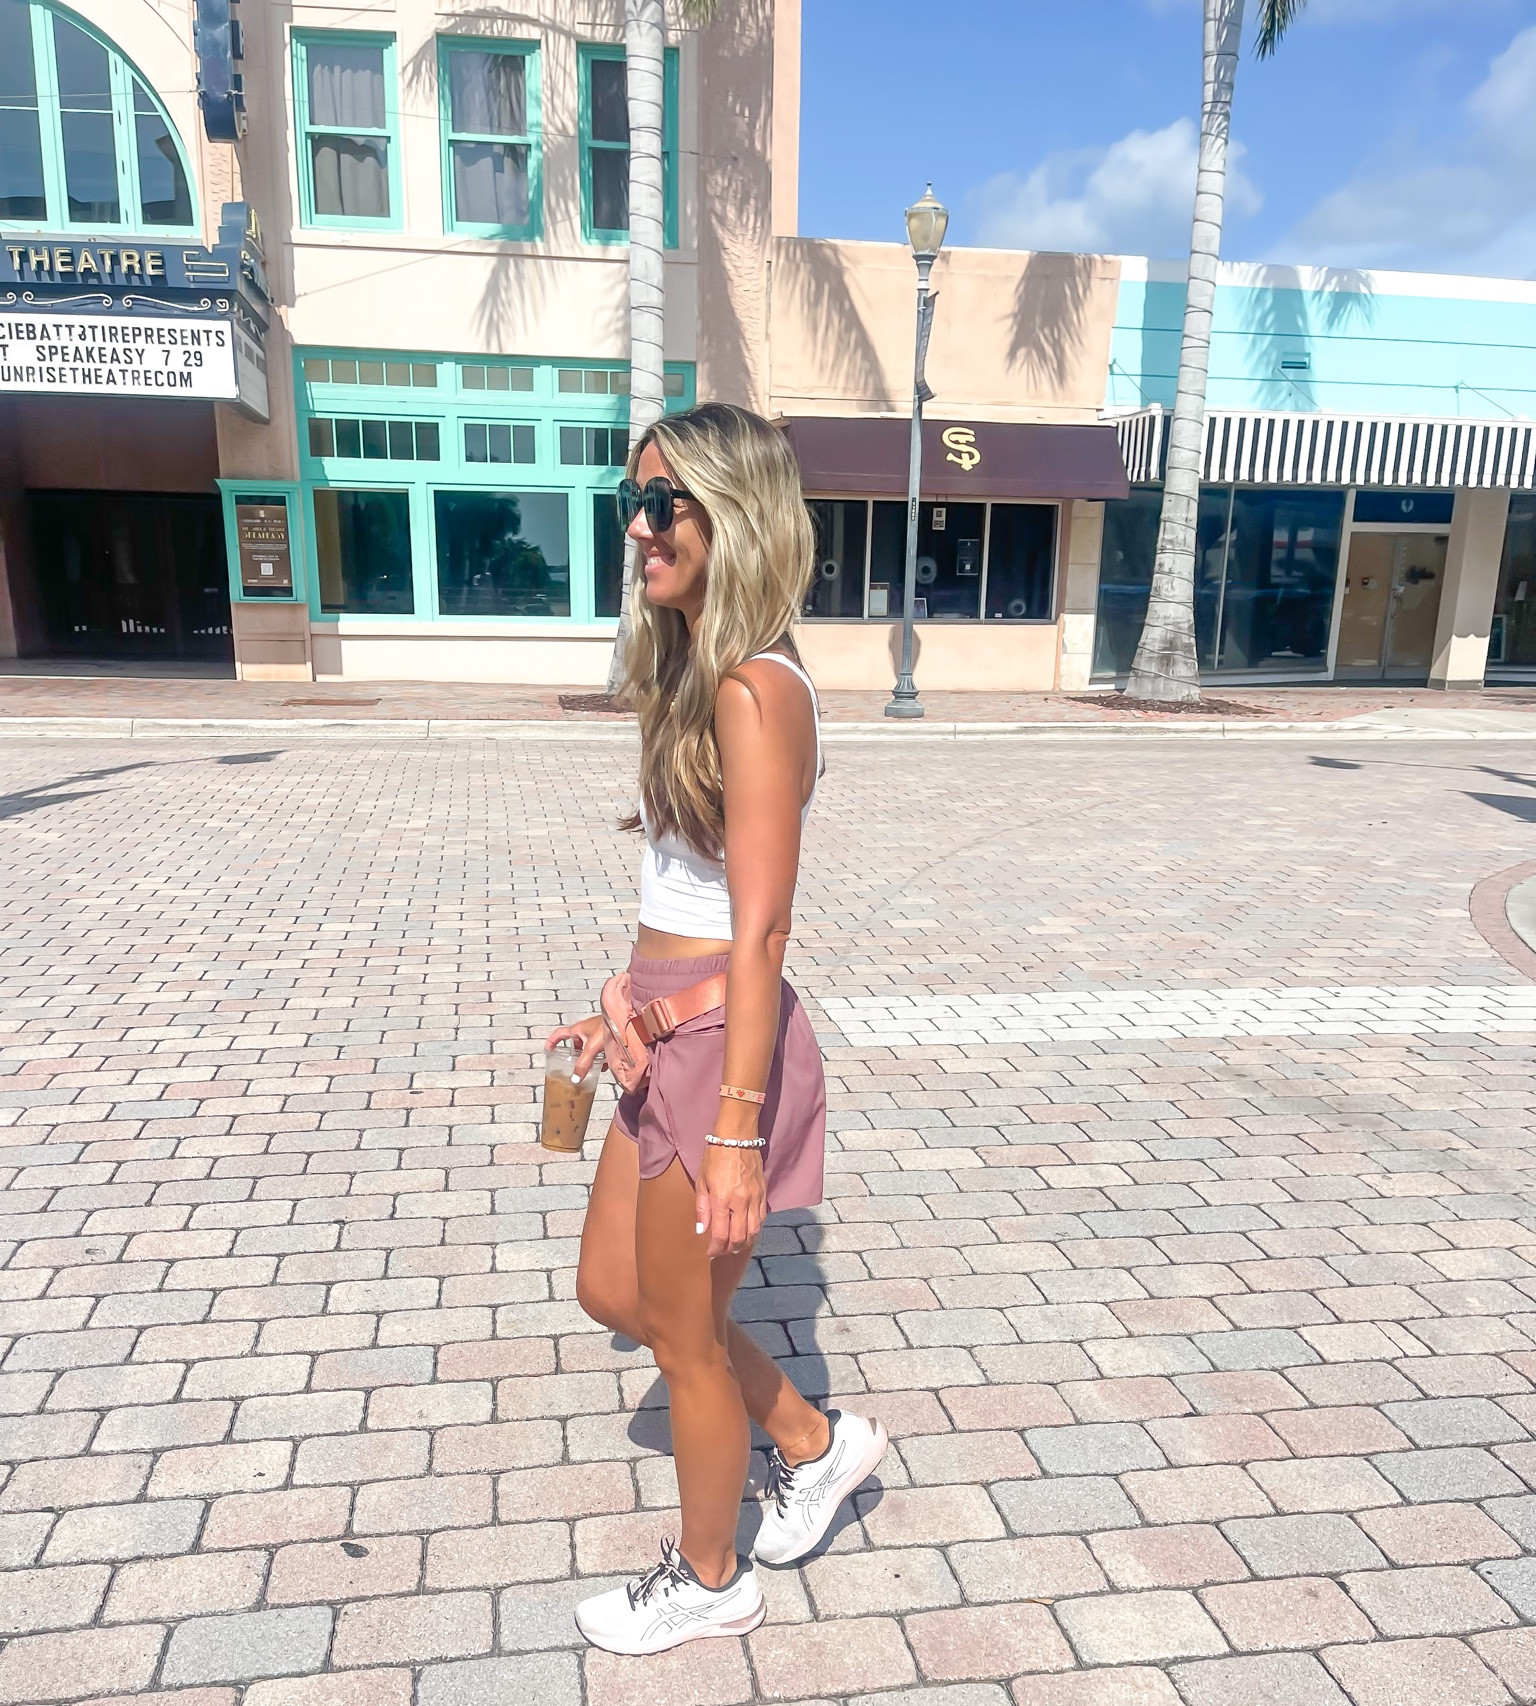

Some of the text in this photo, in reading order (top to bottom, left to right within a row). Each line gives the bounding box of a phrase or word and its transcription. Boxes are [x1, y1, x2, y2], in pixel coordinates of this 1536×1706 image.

[6, 245, 165, 276] THEATRE
[36, 344, 146, 366] SPEAKEASY
[161, 349, 171, 367] 7
[182, 350, 203, 368] 29
